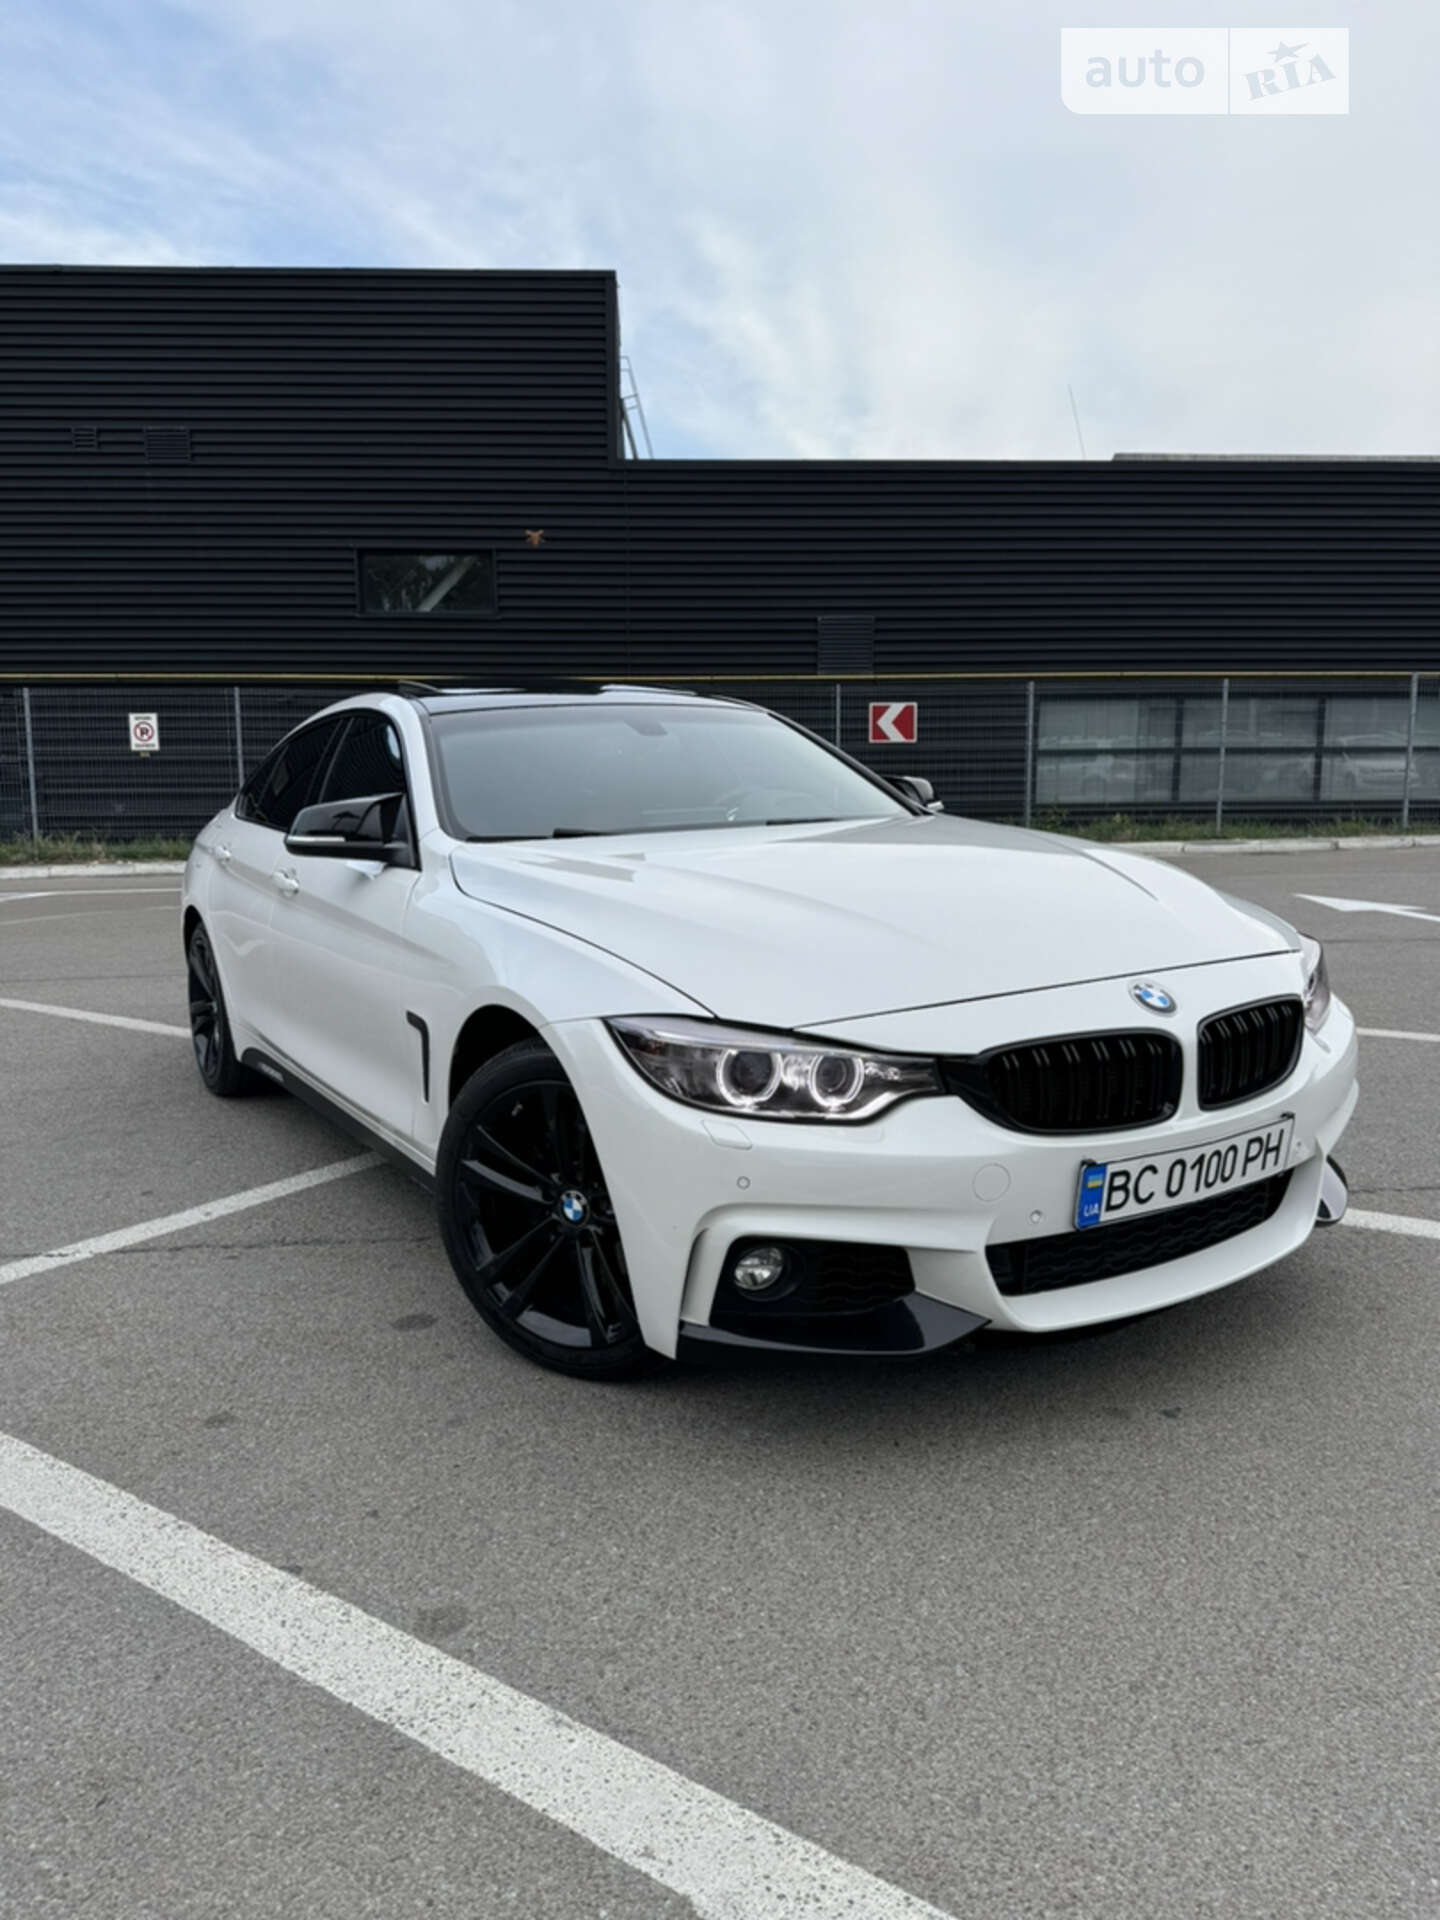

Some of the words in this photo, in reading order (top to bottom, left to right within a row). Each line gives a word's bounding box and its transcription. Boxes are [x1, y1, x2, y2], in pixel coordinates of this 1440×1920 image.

[1105, 1164, 1158, 1212] BC
[1166, 1144, 1239, 1198] 0100
[1241, 1129, 1284, 1177] PH
